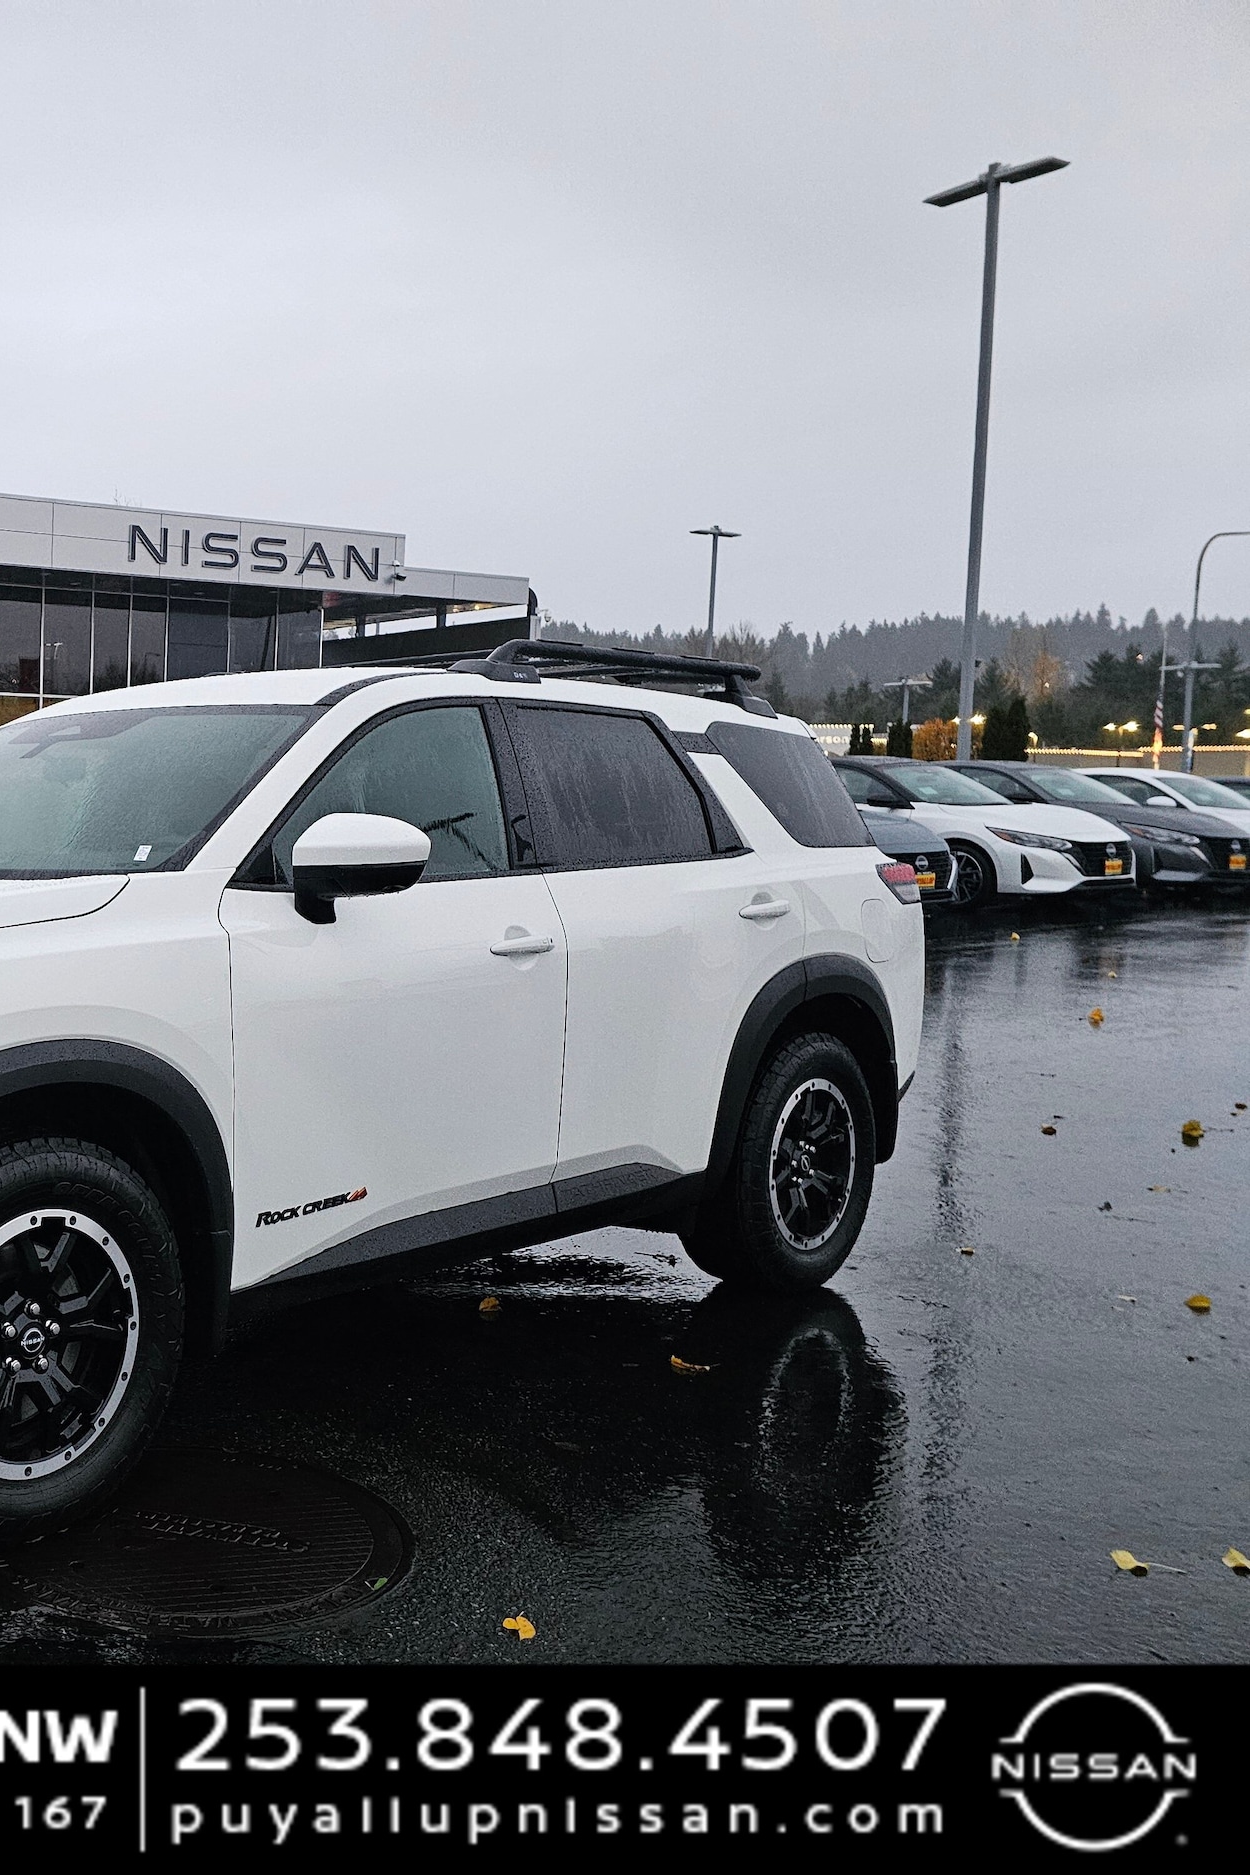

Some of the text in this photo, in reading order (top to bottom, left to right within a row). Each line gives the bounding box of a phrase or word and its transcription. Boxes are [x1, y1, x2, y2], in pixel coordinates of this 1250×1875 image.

[128, 524, 380, 582] NISSAN
[255, 1192, 351, 1229] ROCK CREEK
